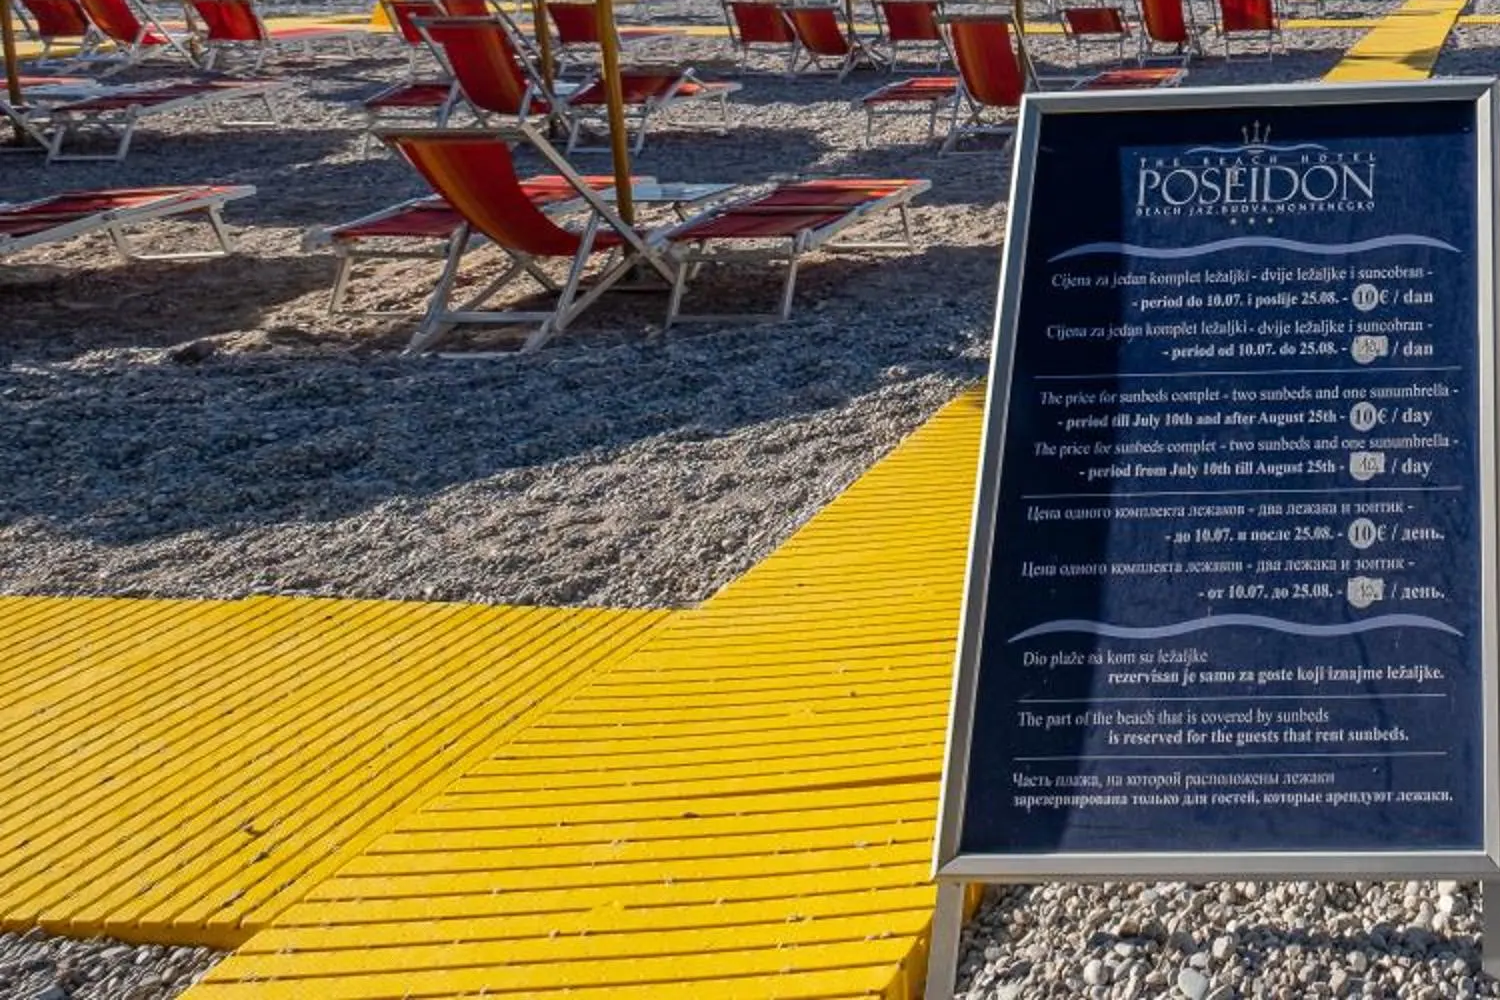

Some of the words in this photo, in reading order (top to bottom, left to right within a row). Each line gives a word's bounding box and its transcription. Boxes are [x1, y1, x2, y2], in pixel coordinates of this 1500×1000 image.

[1140, 157, 1180, 168] THE
[1136, 164, 1376, 206] POSEIDON
[1095, 276, 1109, 286] za
[1150, 270, 1200, 287] komplet
[1261, 267, 1293, 284] dvije
[1358, 265, 1424, 278] suncobran
[1141, 296, 1183, 312] period
[1186, 295, 1203, 307] do
[1207, 294, 1243, 306] 10.07.
[1255, 292, 1298, 309] poslije
[1302, 291, 1339, 304] 25.08.
[1403, 288, 1433, 304] dan
[1040, 392, 1063, 405] The
[1065, 392, 1096, 407] price
[1099, 390, 1117, 403] for
[1120, 388, 1168, 403] sunbeds
[1172, 387, 1220, 404] complet
[1232, 388, 1257, 402] two
[1260, 385, 1312, 400] sunbeds
[1315, 385, 1339, 399] and
[1342, 388, 1366, 398] one
[1066, 415, 1108, 432] period
[1112, 414, 1129, 427] till
[1132, 414, 1160, 430] July
[1166, 412, 1192, 426] 10th
[1196, 412, 1221, 425] and
[1224, 412, 1256, 425] after
[1258, 412, 1304, 427] August
[1308, 409, 1336, 423] 25th
[1402, 408, 1432, 427] day
[1196, 527, 1234, 542] 10.07.
[1294, 526, 1334, 541] 25.08.
[1023, 652, 1047, 667] Dio
[1050, 650, 1085, 669] plaže
[1108, 650, 1135, 664] kom
[1183, 668, 1196, 686] je
[1200, 672, 1235, 682] samo
[1239, 671, 1254, 681] za
[1258, 668, 1293, 685] goste
[1298, 666, 1324, 684] koji
[1328, 665, 1383, 684] iznajme
[1019, 712, 1043, 727] The
[1046, 713, 1072, 730] part
[1075, 712, 1088, 725] of
[1093, 710, 1113, 725] the
[1117, 709, 1154, 725] beach
[1158, 709, 1182, 724] that
[1188, 708, 1197, 724] is
[1201, 708, 1252, 724] covered
[1257, 708, 1272, 726] by
[1277, 707, 1329, 723] sunbeds
[1108, 730, 1119, 744] is
[1123, 729, 1182, 744] reserved
[1187, 729, 1207, 744] for
[1211, 728, 1232, 743] the
[1237, 730, 1279, 746] guests
[1284, 728, 1311, 742] that
[1316, 728, 1344, 742] rent
[1348, 726, 1408, 741] sunbeds.
